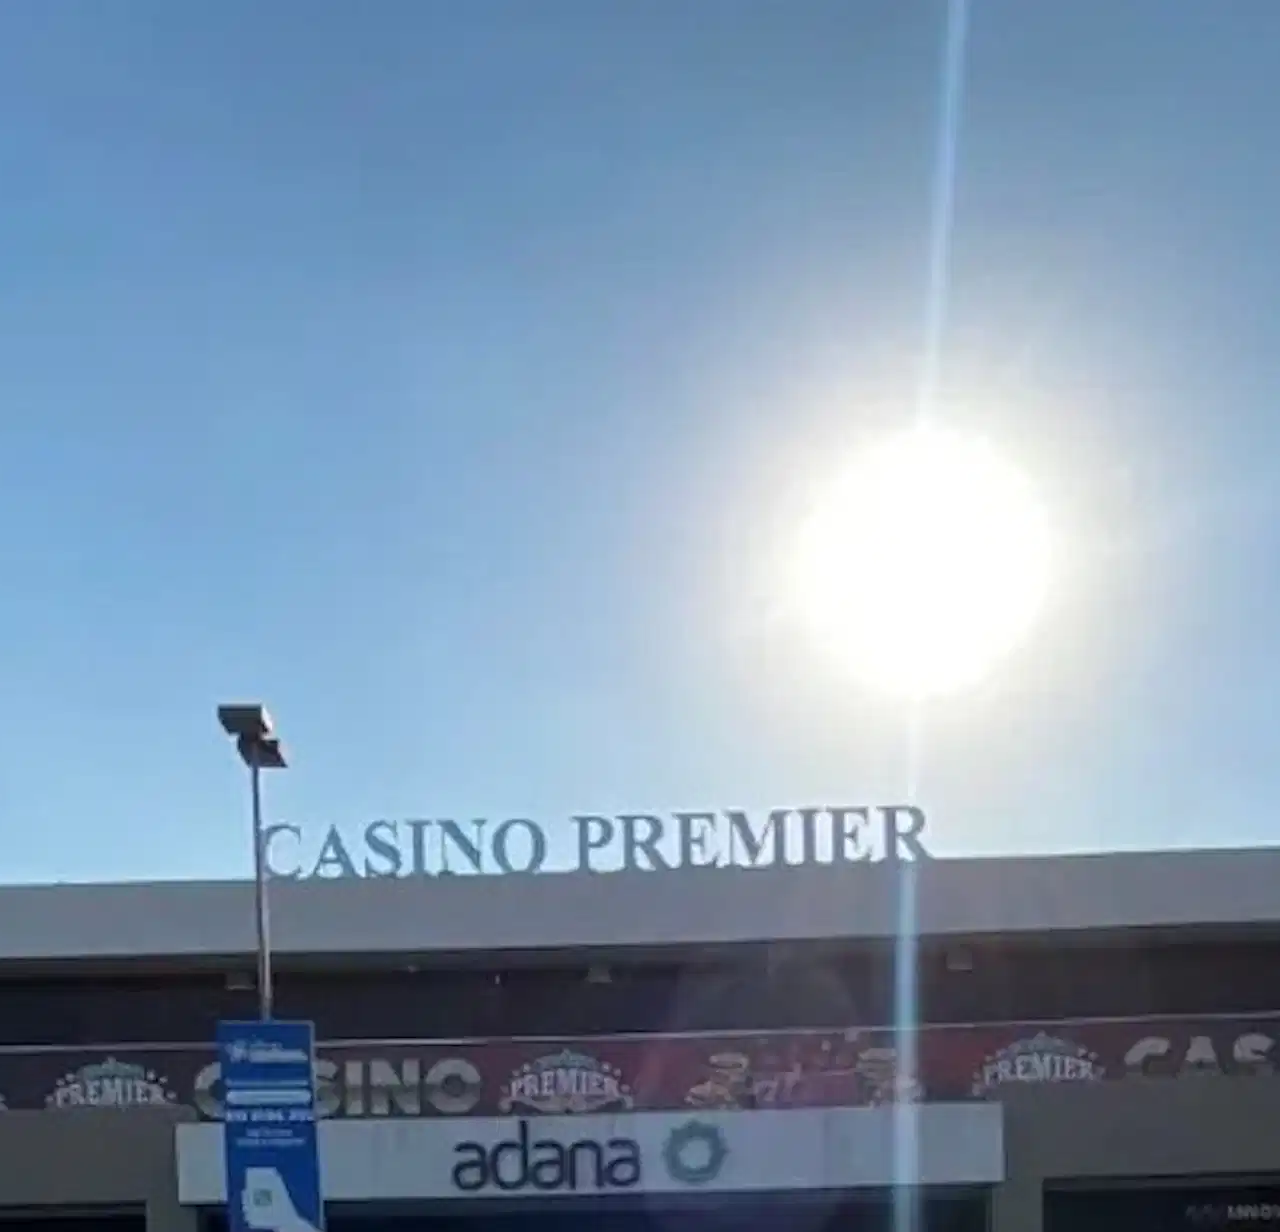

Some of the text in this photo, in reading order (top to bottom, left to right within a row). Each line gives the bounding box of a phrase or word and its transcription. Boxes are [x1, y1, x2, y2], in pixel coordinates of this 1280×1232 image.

[260, 804, 931, 879] CASINO PREMIER
[55, 1077, 164, 1107] PREMIER
[195, 1057, 481, 1117] CSINO
[511, 1068, 620, 1099] PREMIER
[983, 1052, 1095, 1086] PREMIER
[452, 1120, 641, 1190] adana
